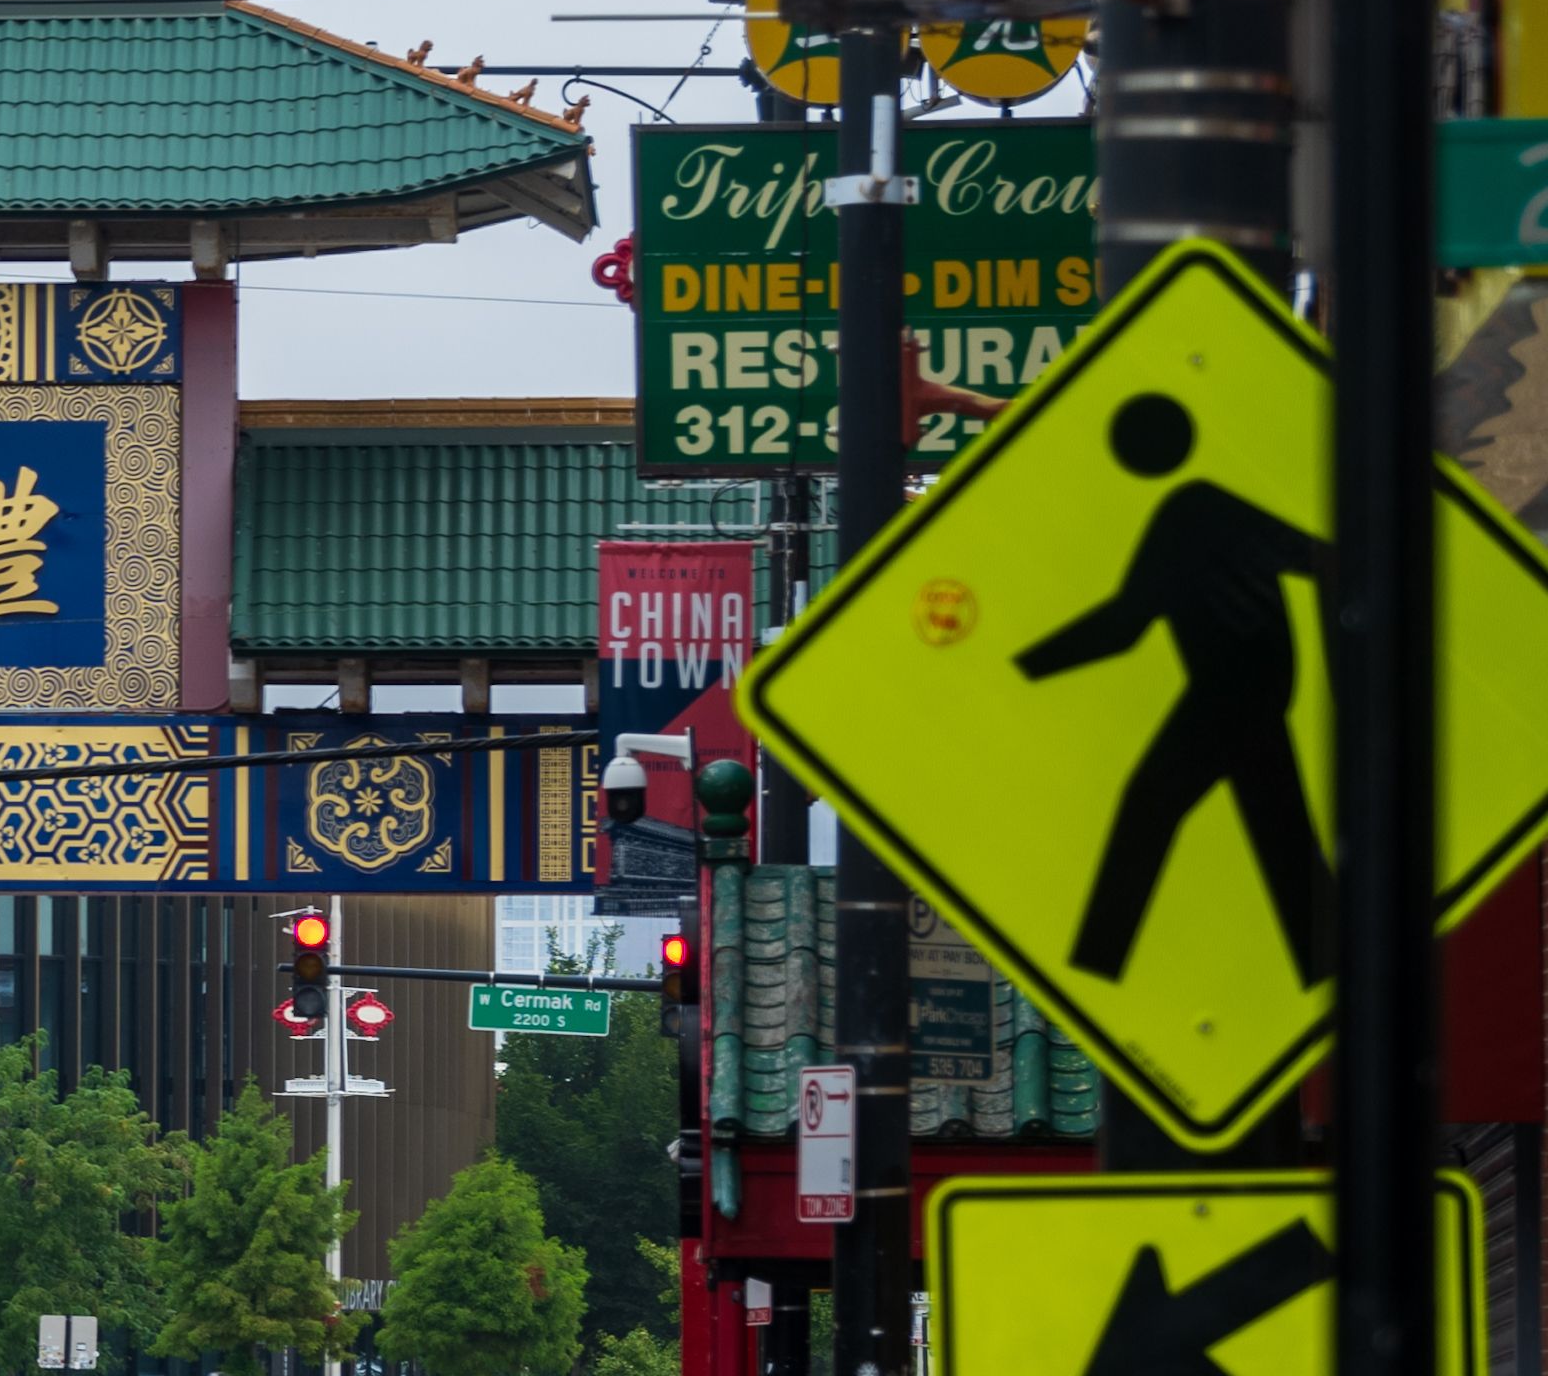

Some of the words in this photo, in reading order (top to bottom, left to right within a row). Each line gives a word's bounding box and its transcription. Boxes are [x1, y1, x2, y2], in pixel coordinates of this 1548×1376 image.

[661, 143, 839, 250] Trip
[662, 261, 839, 312] DINE-I
[934, 259, 1040, 309] DIM
[628, 568, 698, 580] WELCOME
[709, 568, 726, 579] TO
[610, 591, 744, 640] CHINA
[608, 641, 744, 690] TOWN
[943, 951, 961, 964] PAY
[479, 993, 490, 1006] W
[501, 990, 573, 1010] Cermak
[584, 999, 601, 1012] Rd
[513, 1013, 549, 1027] 2200
[557, 1015, 566, 1027] S
[805, 1198, 822, 1216] TOW
[826, 1198, 847, 1216] ZONE
